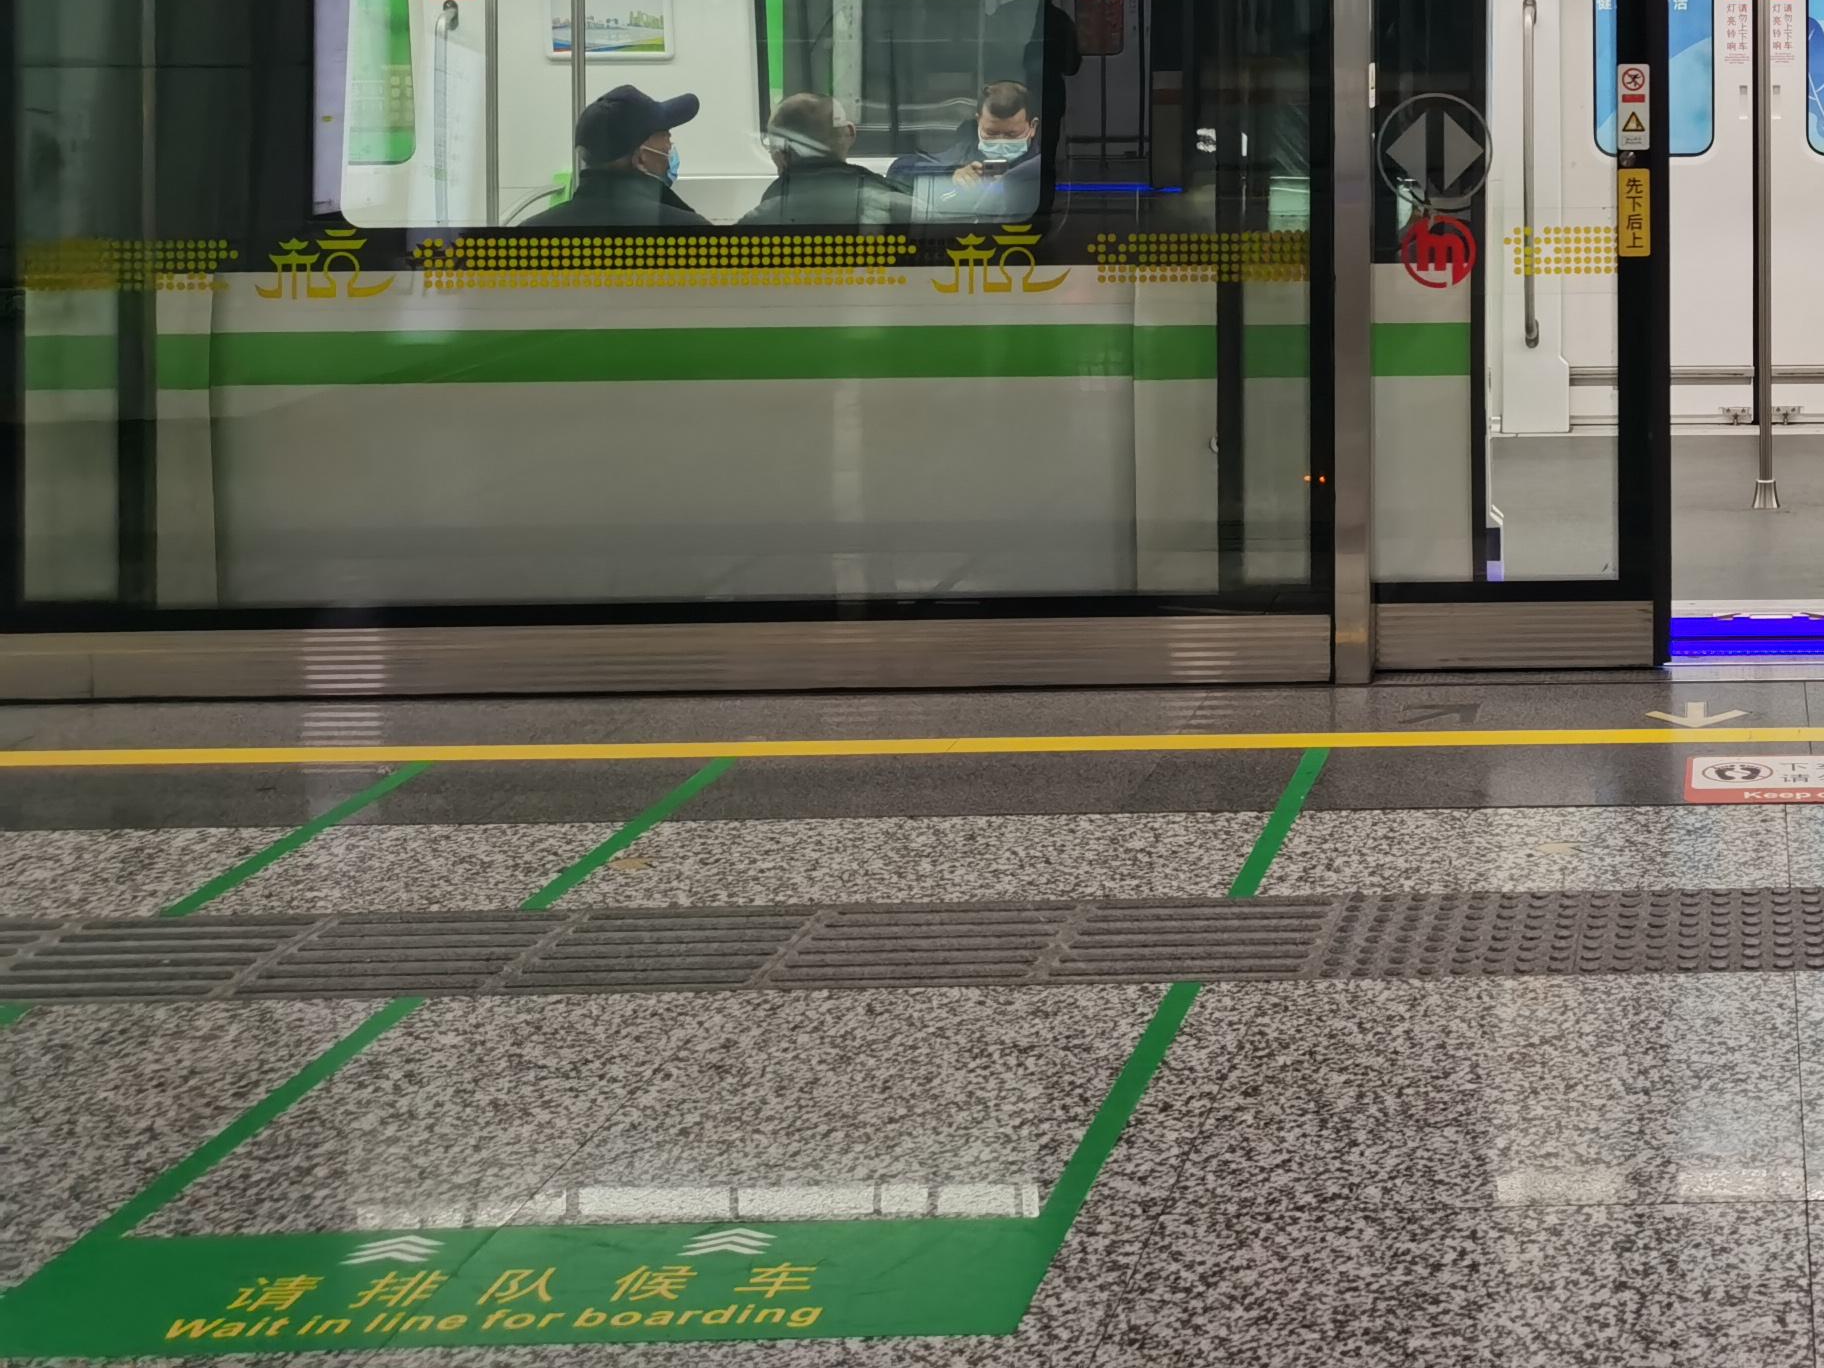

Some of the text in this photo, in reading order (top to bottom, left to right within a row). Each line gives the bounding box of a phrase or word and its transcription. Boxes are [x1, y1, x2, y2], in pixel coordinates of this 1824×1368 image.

[1625, 177, 1644, 249] 先下后上
[1744, 791, 1811, 800] Keep
[225, 1263, 818, 1312] 请排队候车
[166, 1303, 824, 1339] Wait in line for boarding
